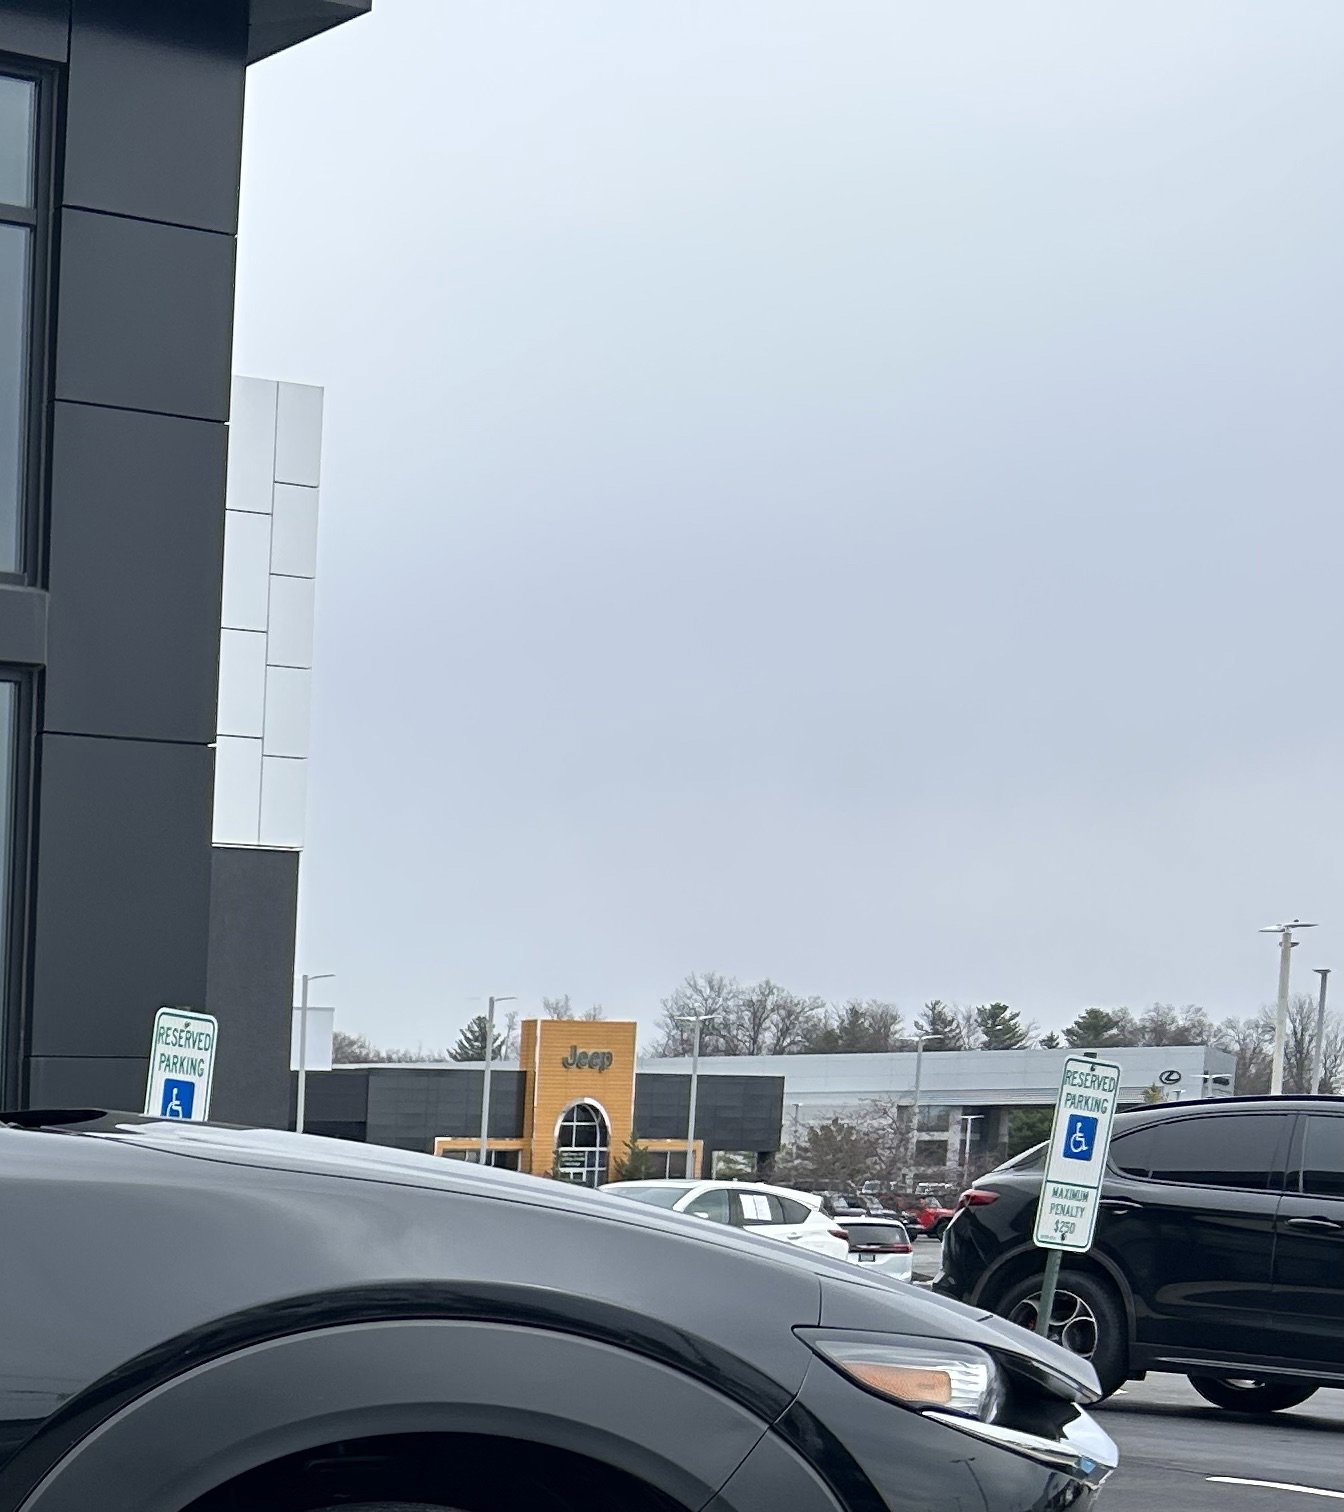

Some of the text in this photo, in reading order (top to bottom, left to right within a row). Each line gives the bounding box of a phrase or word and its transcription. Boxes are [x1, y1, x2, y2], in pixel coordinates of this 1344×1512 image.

[157, 1026, 211, 1051] RESERVED
[158, 1053, 205, 1078] PARKING
[561, 1045, 613, 1073] Jeep
[1065, 1069, 1116, 1092] RESERVED
[1064, 1092, 1109, 1114] PARKING
[1052, 1186, 1089, 1202] MAXIMUM
[1049, 1202, 1085, 1218] PENALTY
[1054, 1219, 1076, 1234] $250
